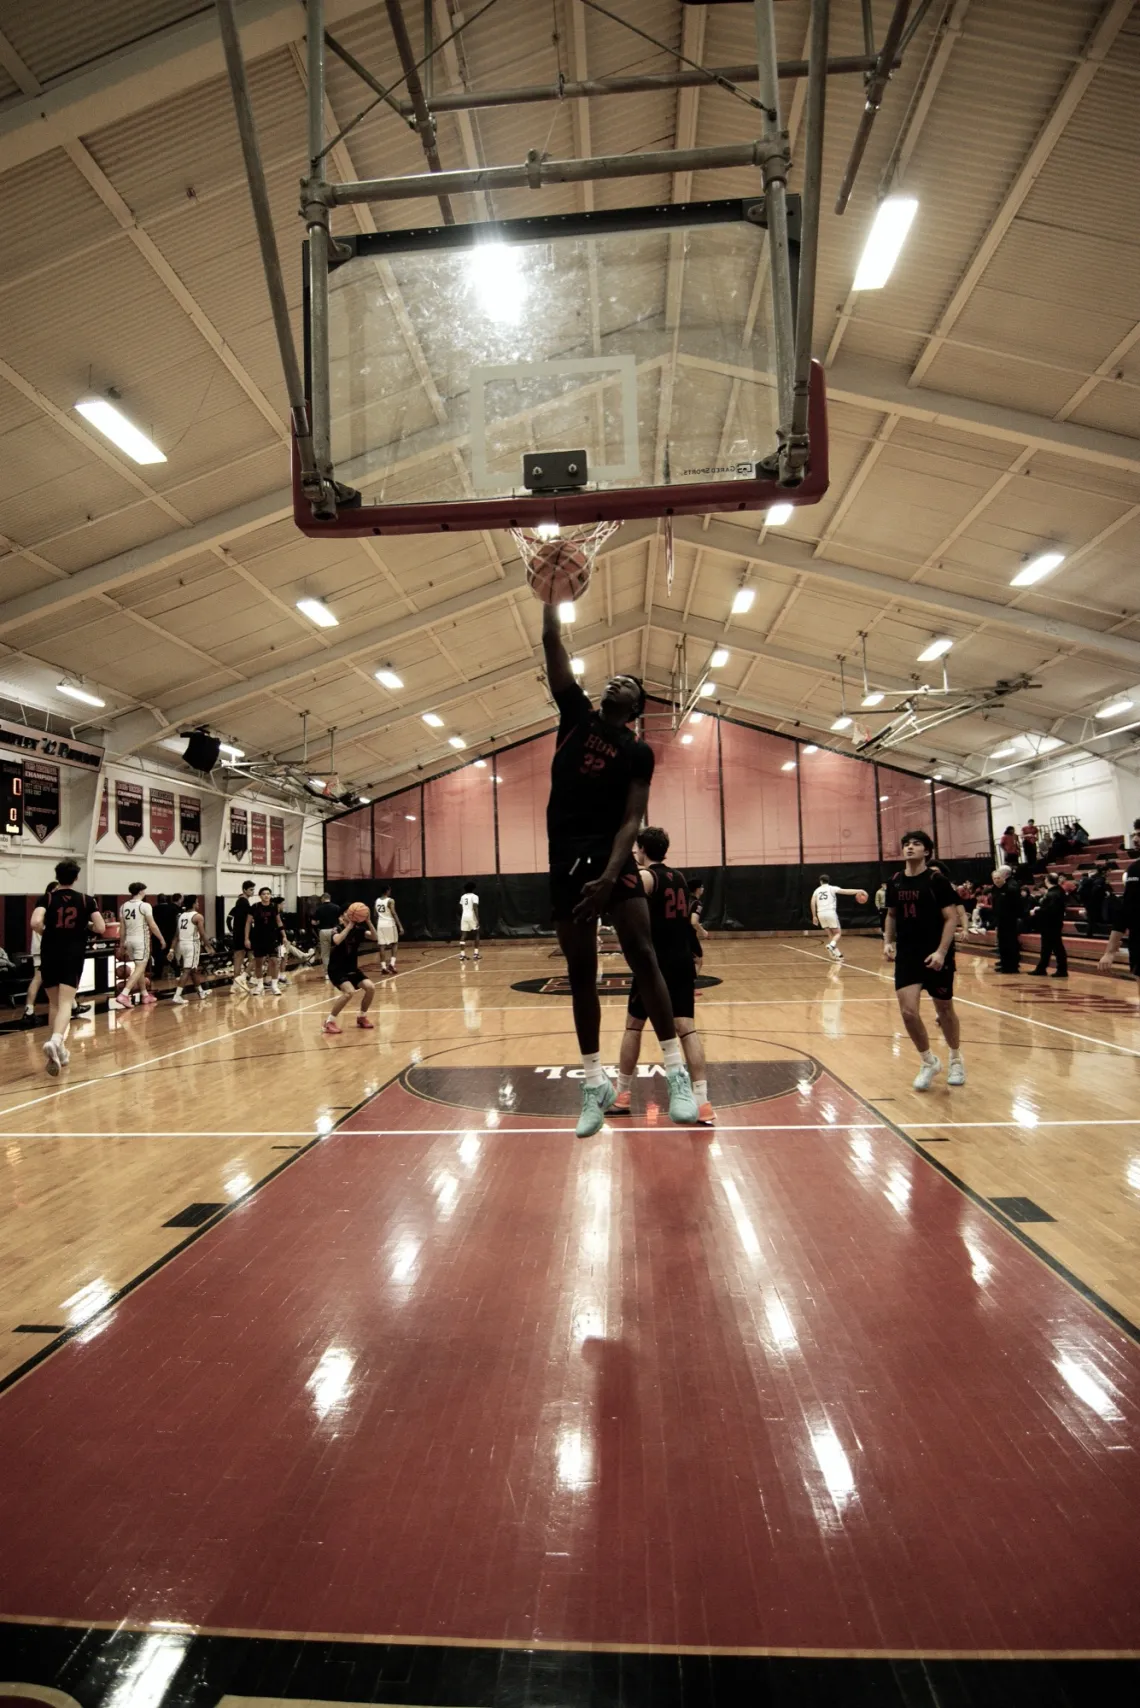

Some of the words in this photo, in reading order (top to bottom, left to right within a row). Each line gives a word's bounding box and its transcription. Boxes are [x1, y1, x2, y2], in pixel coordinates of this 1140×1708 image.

[12, 777, 22, 796] 0
[9, 808, 18, 822] 0
[818, 891, 828, 901] 25
[898, 889, 920, 901] HUN
[377, 904, 386, 913] 23
[664, 887, 689, 919] 24
[55, 906, 78, 929] 12
[124, 908, 136, 920] 24
[903, 902, 917, 920] 14
[180, 918, 189, 930] 12
